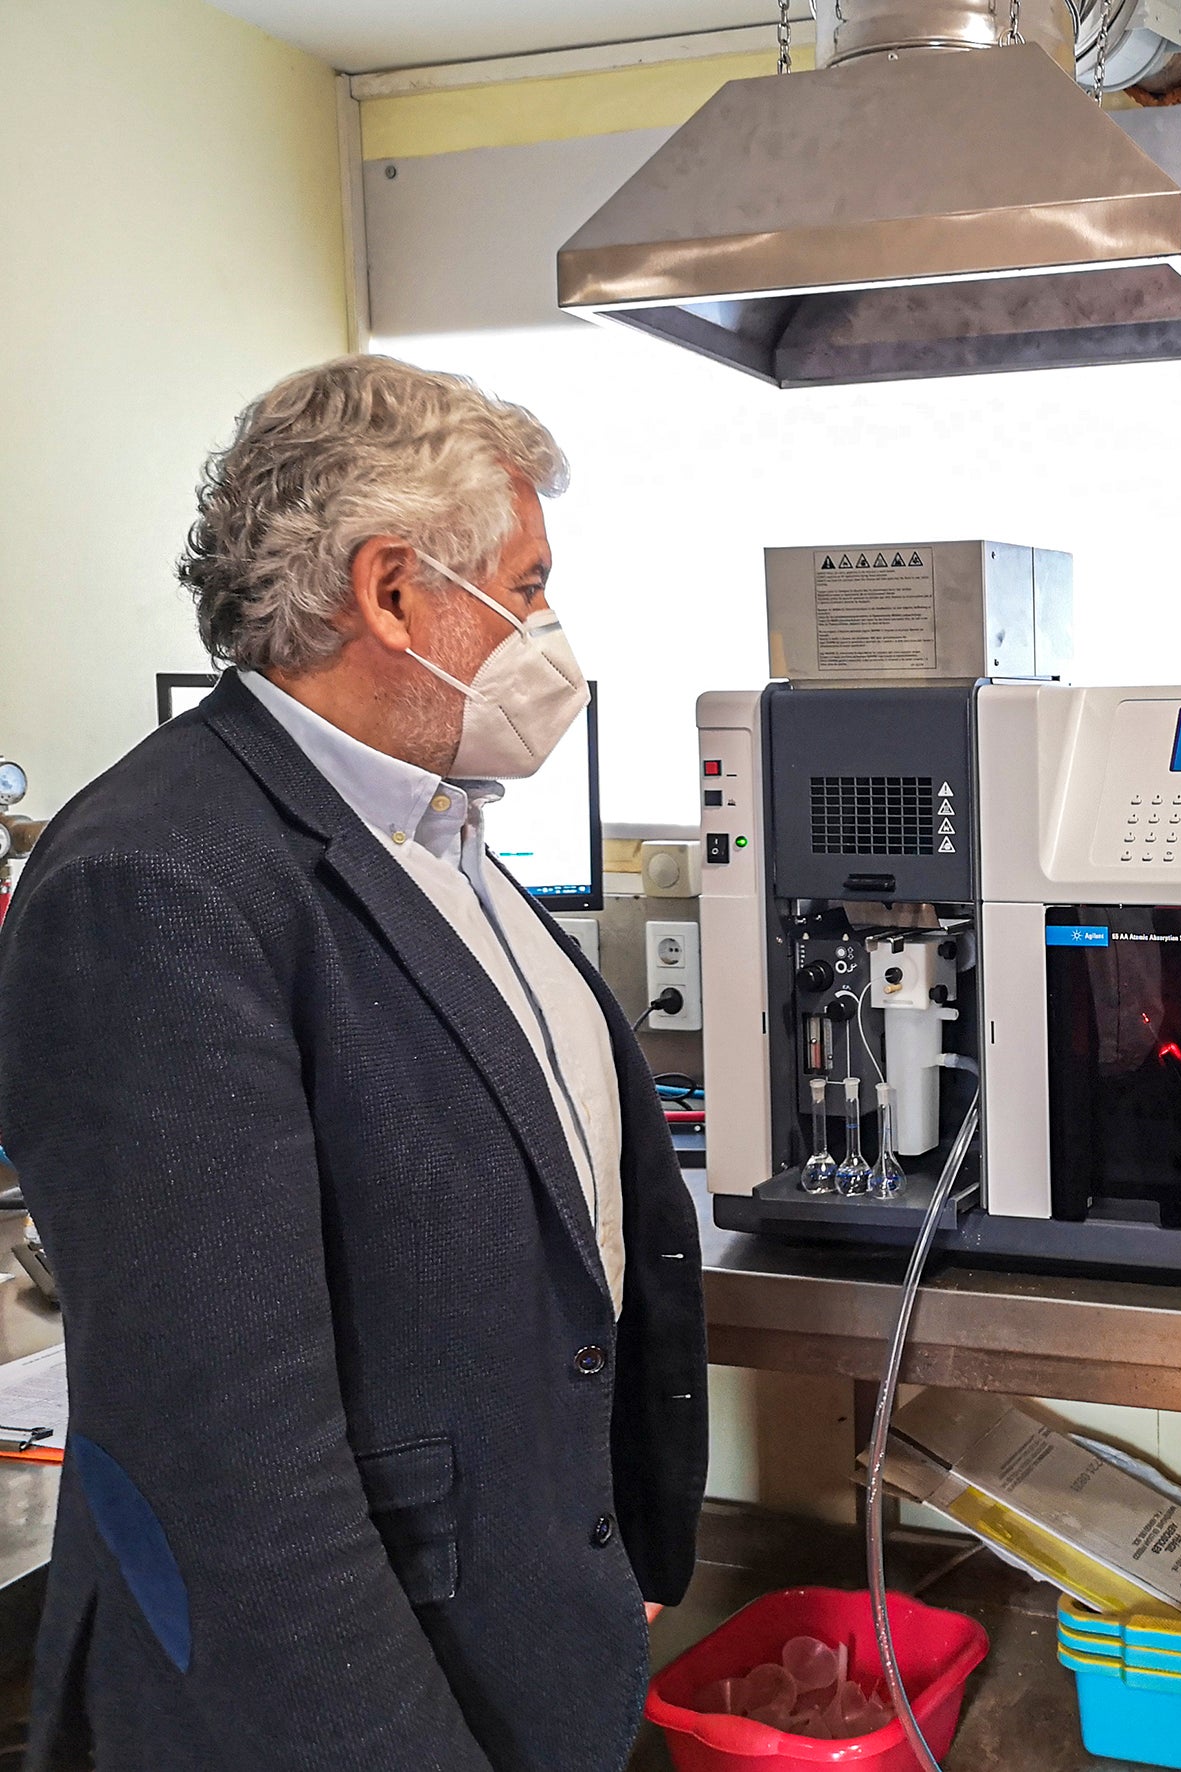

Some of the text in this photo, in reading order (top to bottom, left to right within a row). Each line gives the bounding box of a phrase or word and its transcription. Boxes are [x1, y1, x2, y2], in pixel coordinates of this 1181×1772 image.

[1084, 932, 1105, 941] Agilent
[1119, 932, 1129, 941] AA
[1129, 933, 1149, 941] Atomic
[1149, 933, 1179, 943] Absorption
[1151, 1522, 1178, 1554] AEROSOLES
